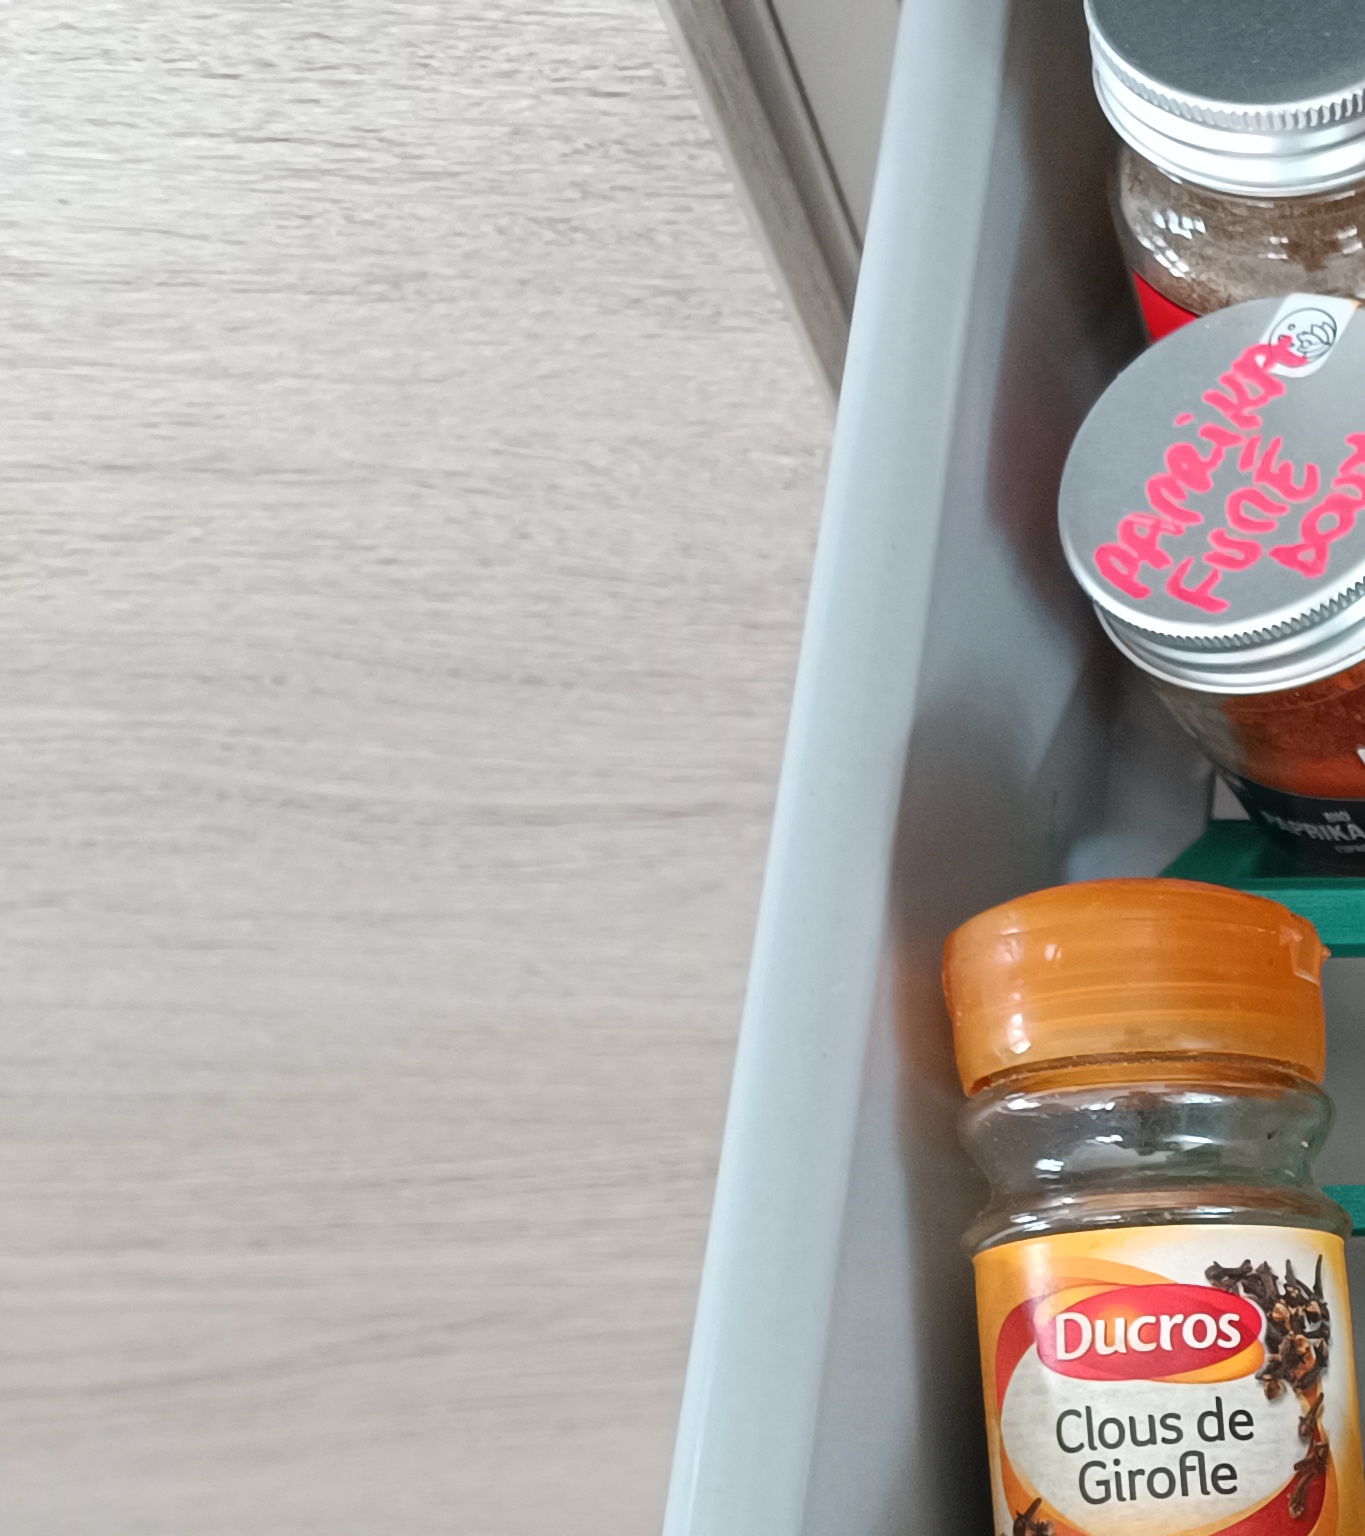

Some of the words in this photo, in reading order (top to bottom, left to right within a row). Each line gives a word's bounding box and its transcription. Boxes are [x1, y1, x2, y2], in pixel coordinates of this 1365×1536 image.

[1054, 1310, 1243, 1361] Ducros
[1055, 1404, 1184, 1454] Clous
[1196, 1395, 1255, 1443] de
[1078, 1450, 1239, 1506] Girofle
